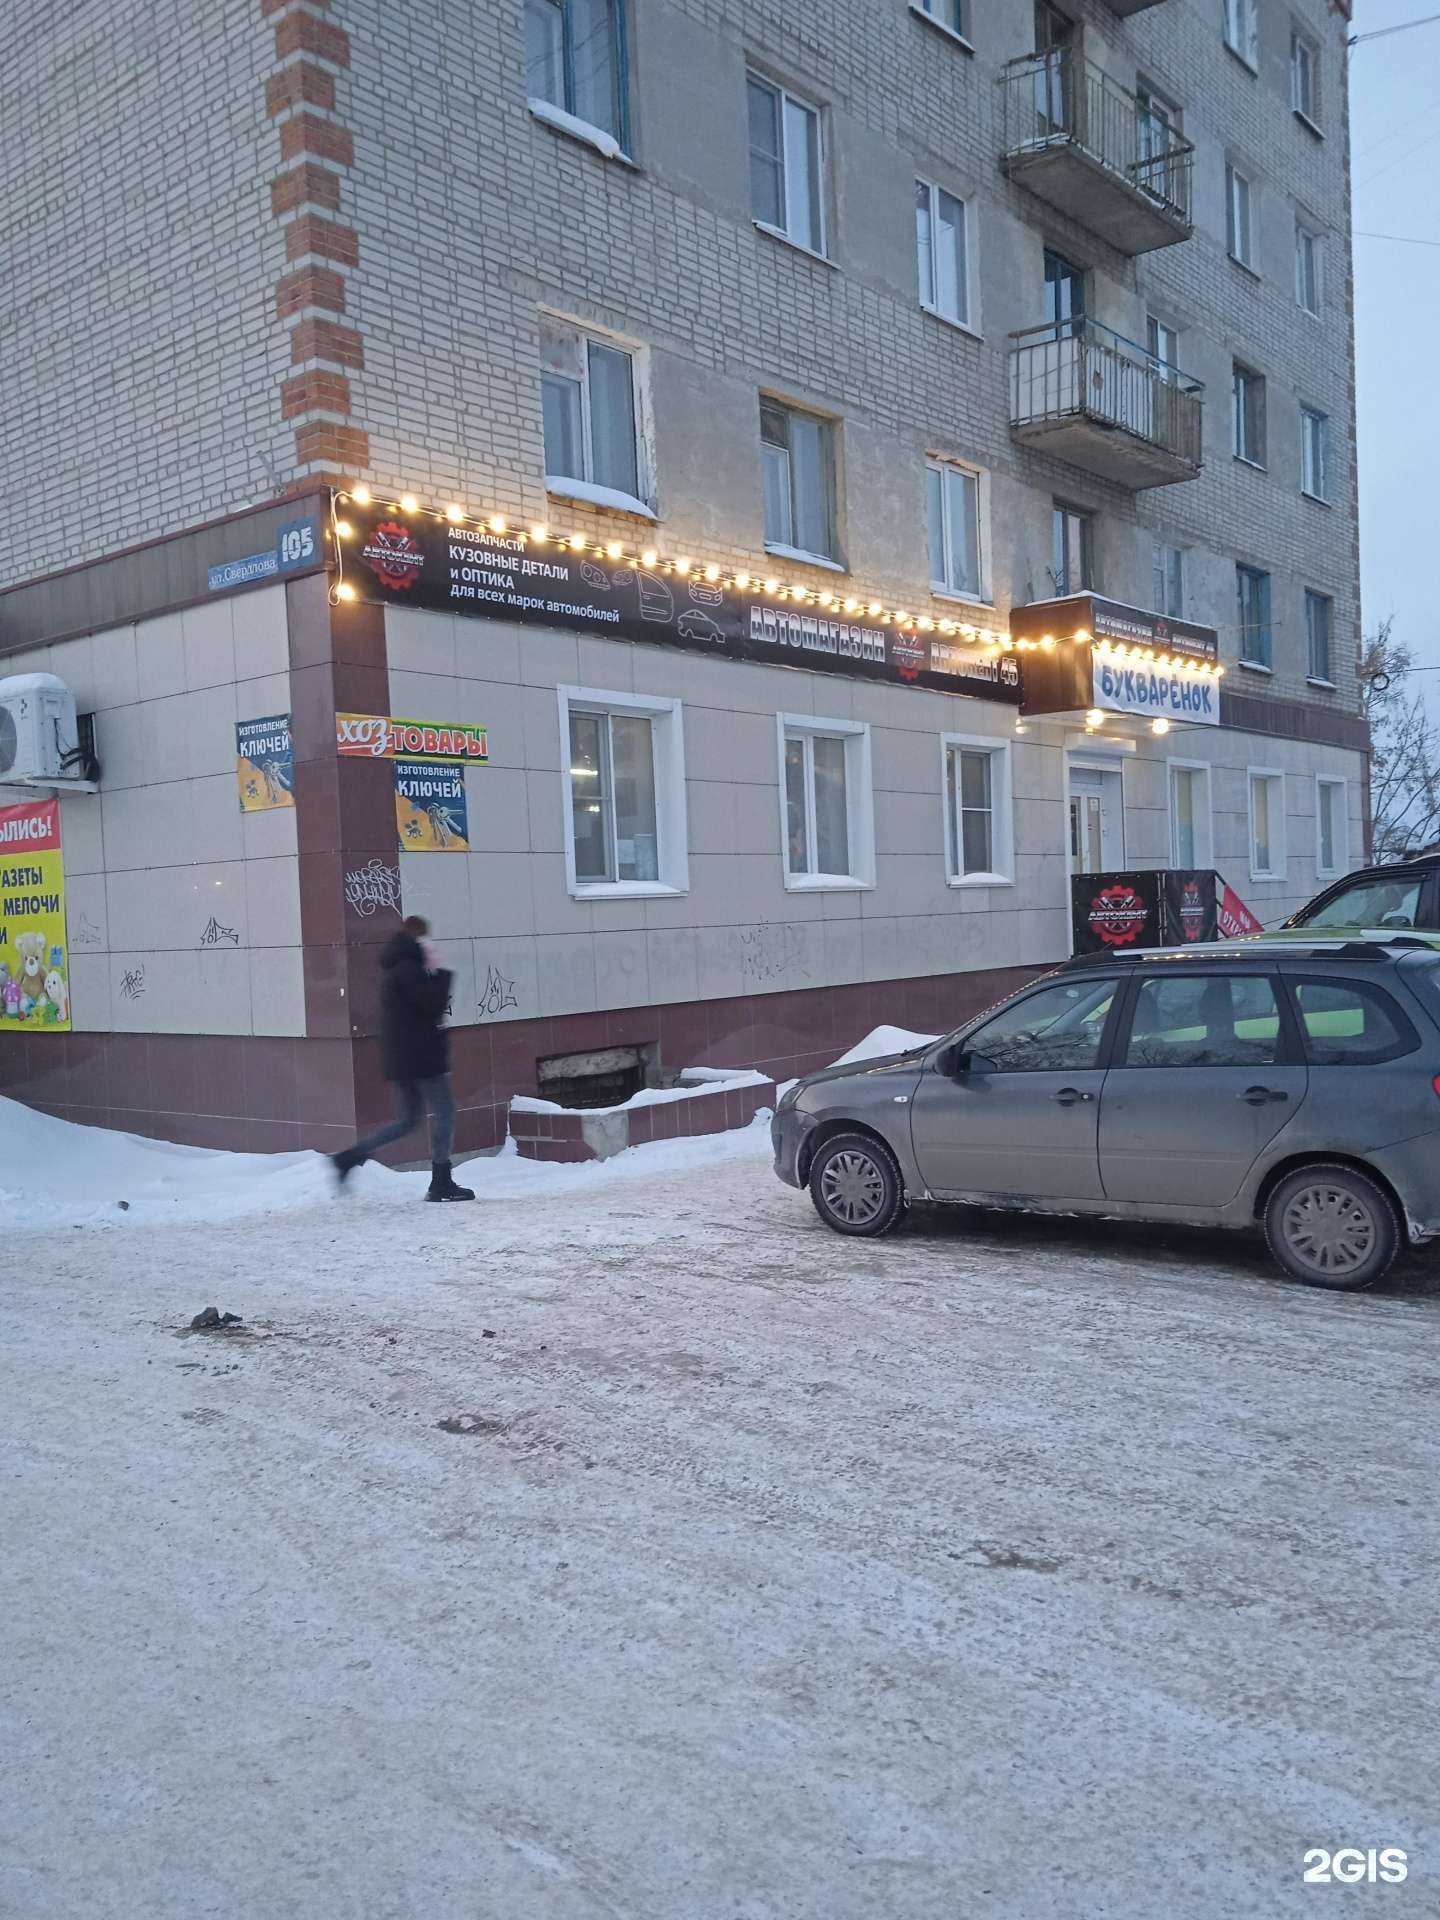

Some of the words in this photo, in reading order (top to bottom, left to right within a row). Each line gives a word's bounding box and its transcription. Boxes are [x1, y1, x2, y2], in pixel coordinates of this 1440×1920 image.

[281, 525, 314, 562] 105
[448, 527, 525, 553] АВТОЗАПЧАСТИ
[449, 545, 519, 572] КУЗОВНЫЕ
[522, 560, 569, 581] ДЕТАЛИ
[461, 567, 515, 589] ОПТИКА
[450, 584, 475, 599] для
[478, 588, 505, 603] всех
[507, 593, 544, 612] марок
[547, 600, 619, 623] автомобилей
[750, 606, 885, 663] АВТОМАГАЗИН
[1101, 665, 1212, 714] БУКВАРЁНОК
[238, 719, 288, 736] ИЗГОТОВЛЕНИЕ
[240, 733, 289, 757] КЛЮЧЕЙ
[398, 765, 460, 777] ИЗГОТОВЛЕНИЕ
[399, 779, 461, 799] КЛЮЧЕЙ
[0, 866, 43, 888] АЗЕТЫ
[3, 894, 60, 916] МЕЛОЧИ
